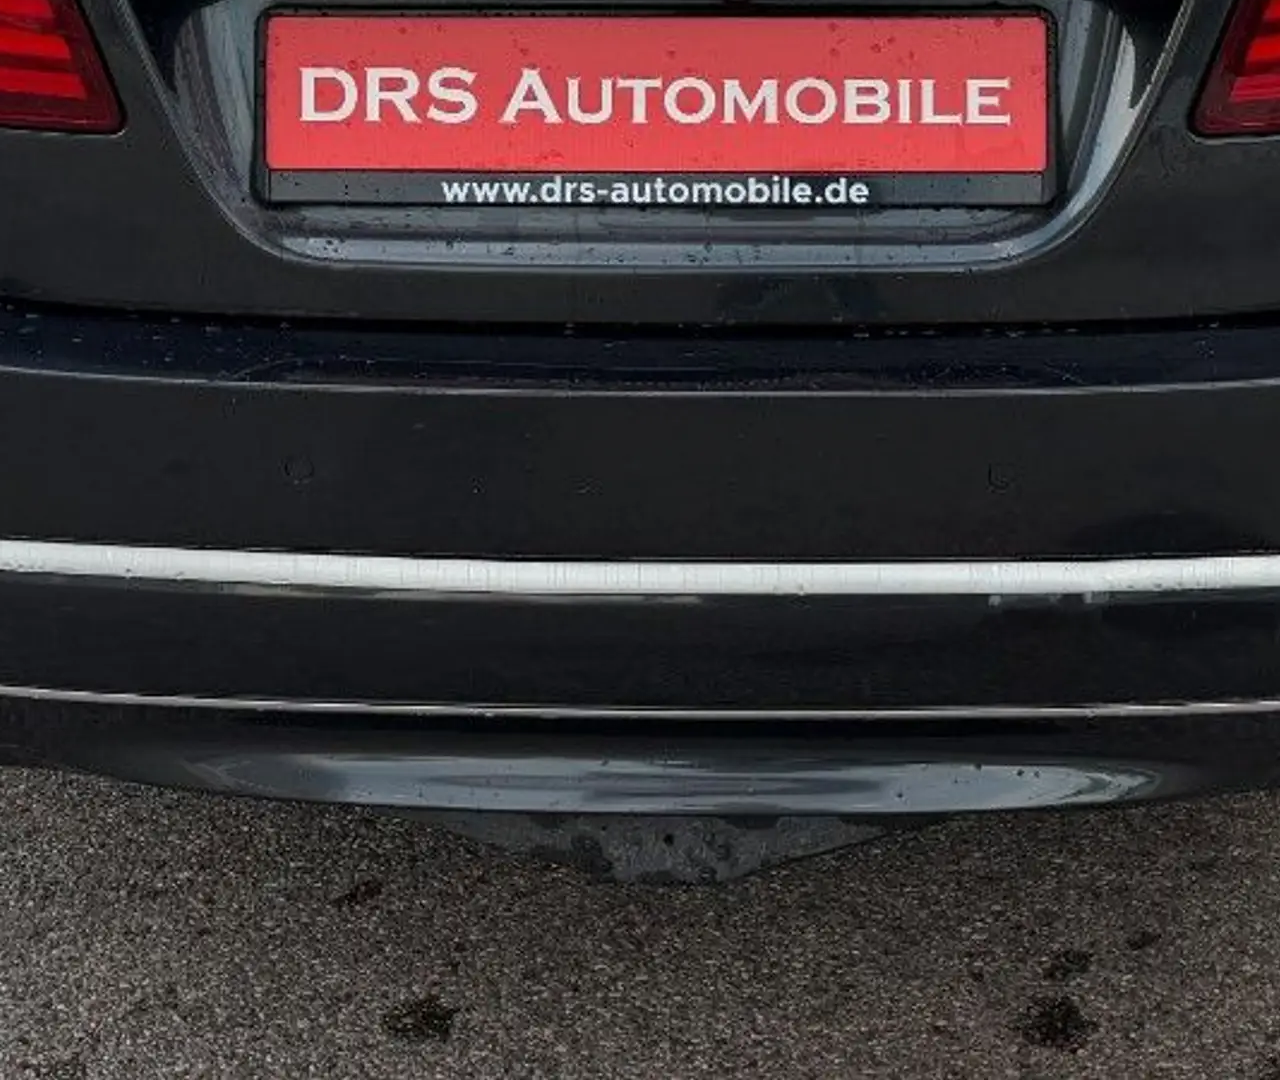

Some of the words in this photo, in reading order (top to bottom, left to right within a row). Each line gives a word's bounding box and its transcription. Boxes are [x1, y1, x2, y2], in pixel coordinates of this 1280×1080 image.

[299, 67, 478, 124] DRS
[499, 67, 1012, 126] AUTOMOBILE
[440, 175, 870, 205] www.drs-automobile.de
